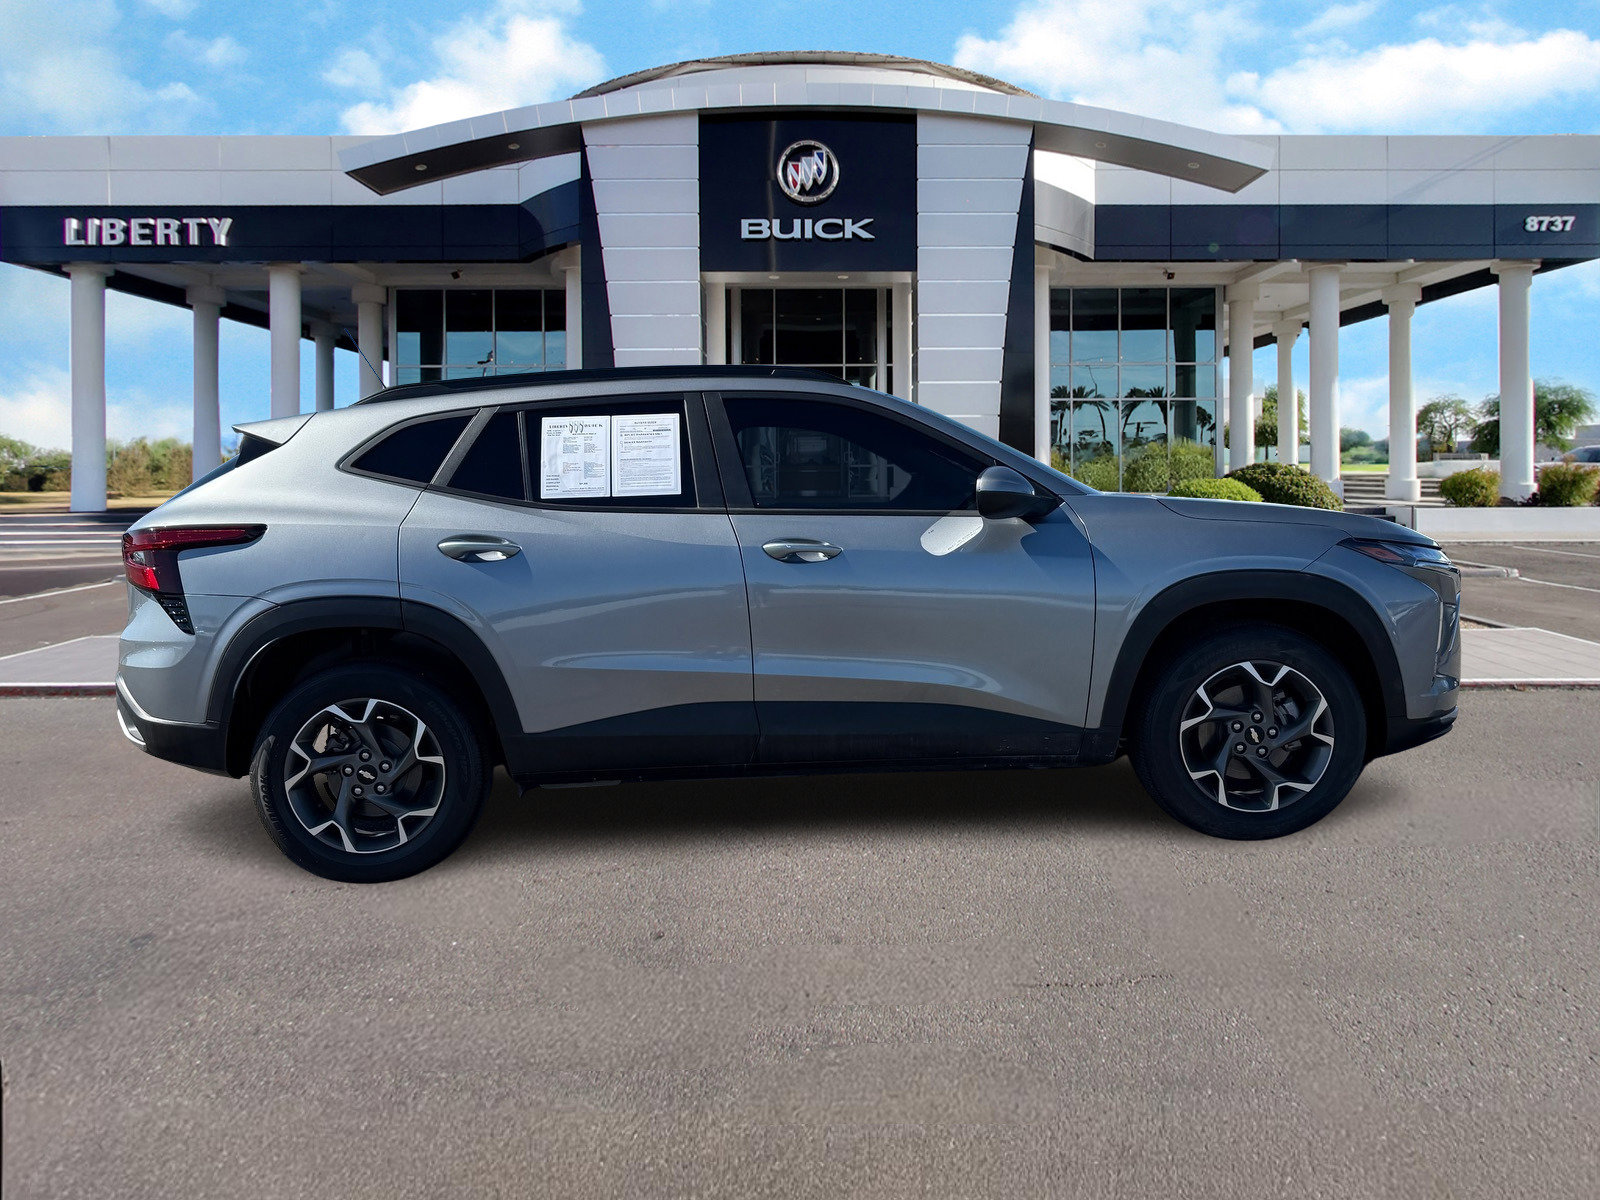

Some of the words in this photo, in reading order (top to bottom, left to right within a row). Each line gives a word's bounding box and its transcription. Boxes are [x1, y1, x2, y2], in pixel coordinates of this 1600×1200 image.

[64, 217, 233, 246] LIBERTY
[740, 218, 876, 240] BUICK
[1525, 215, 1576, 232] 8737
